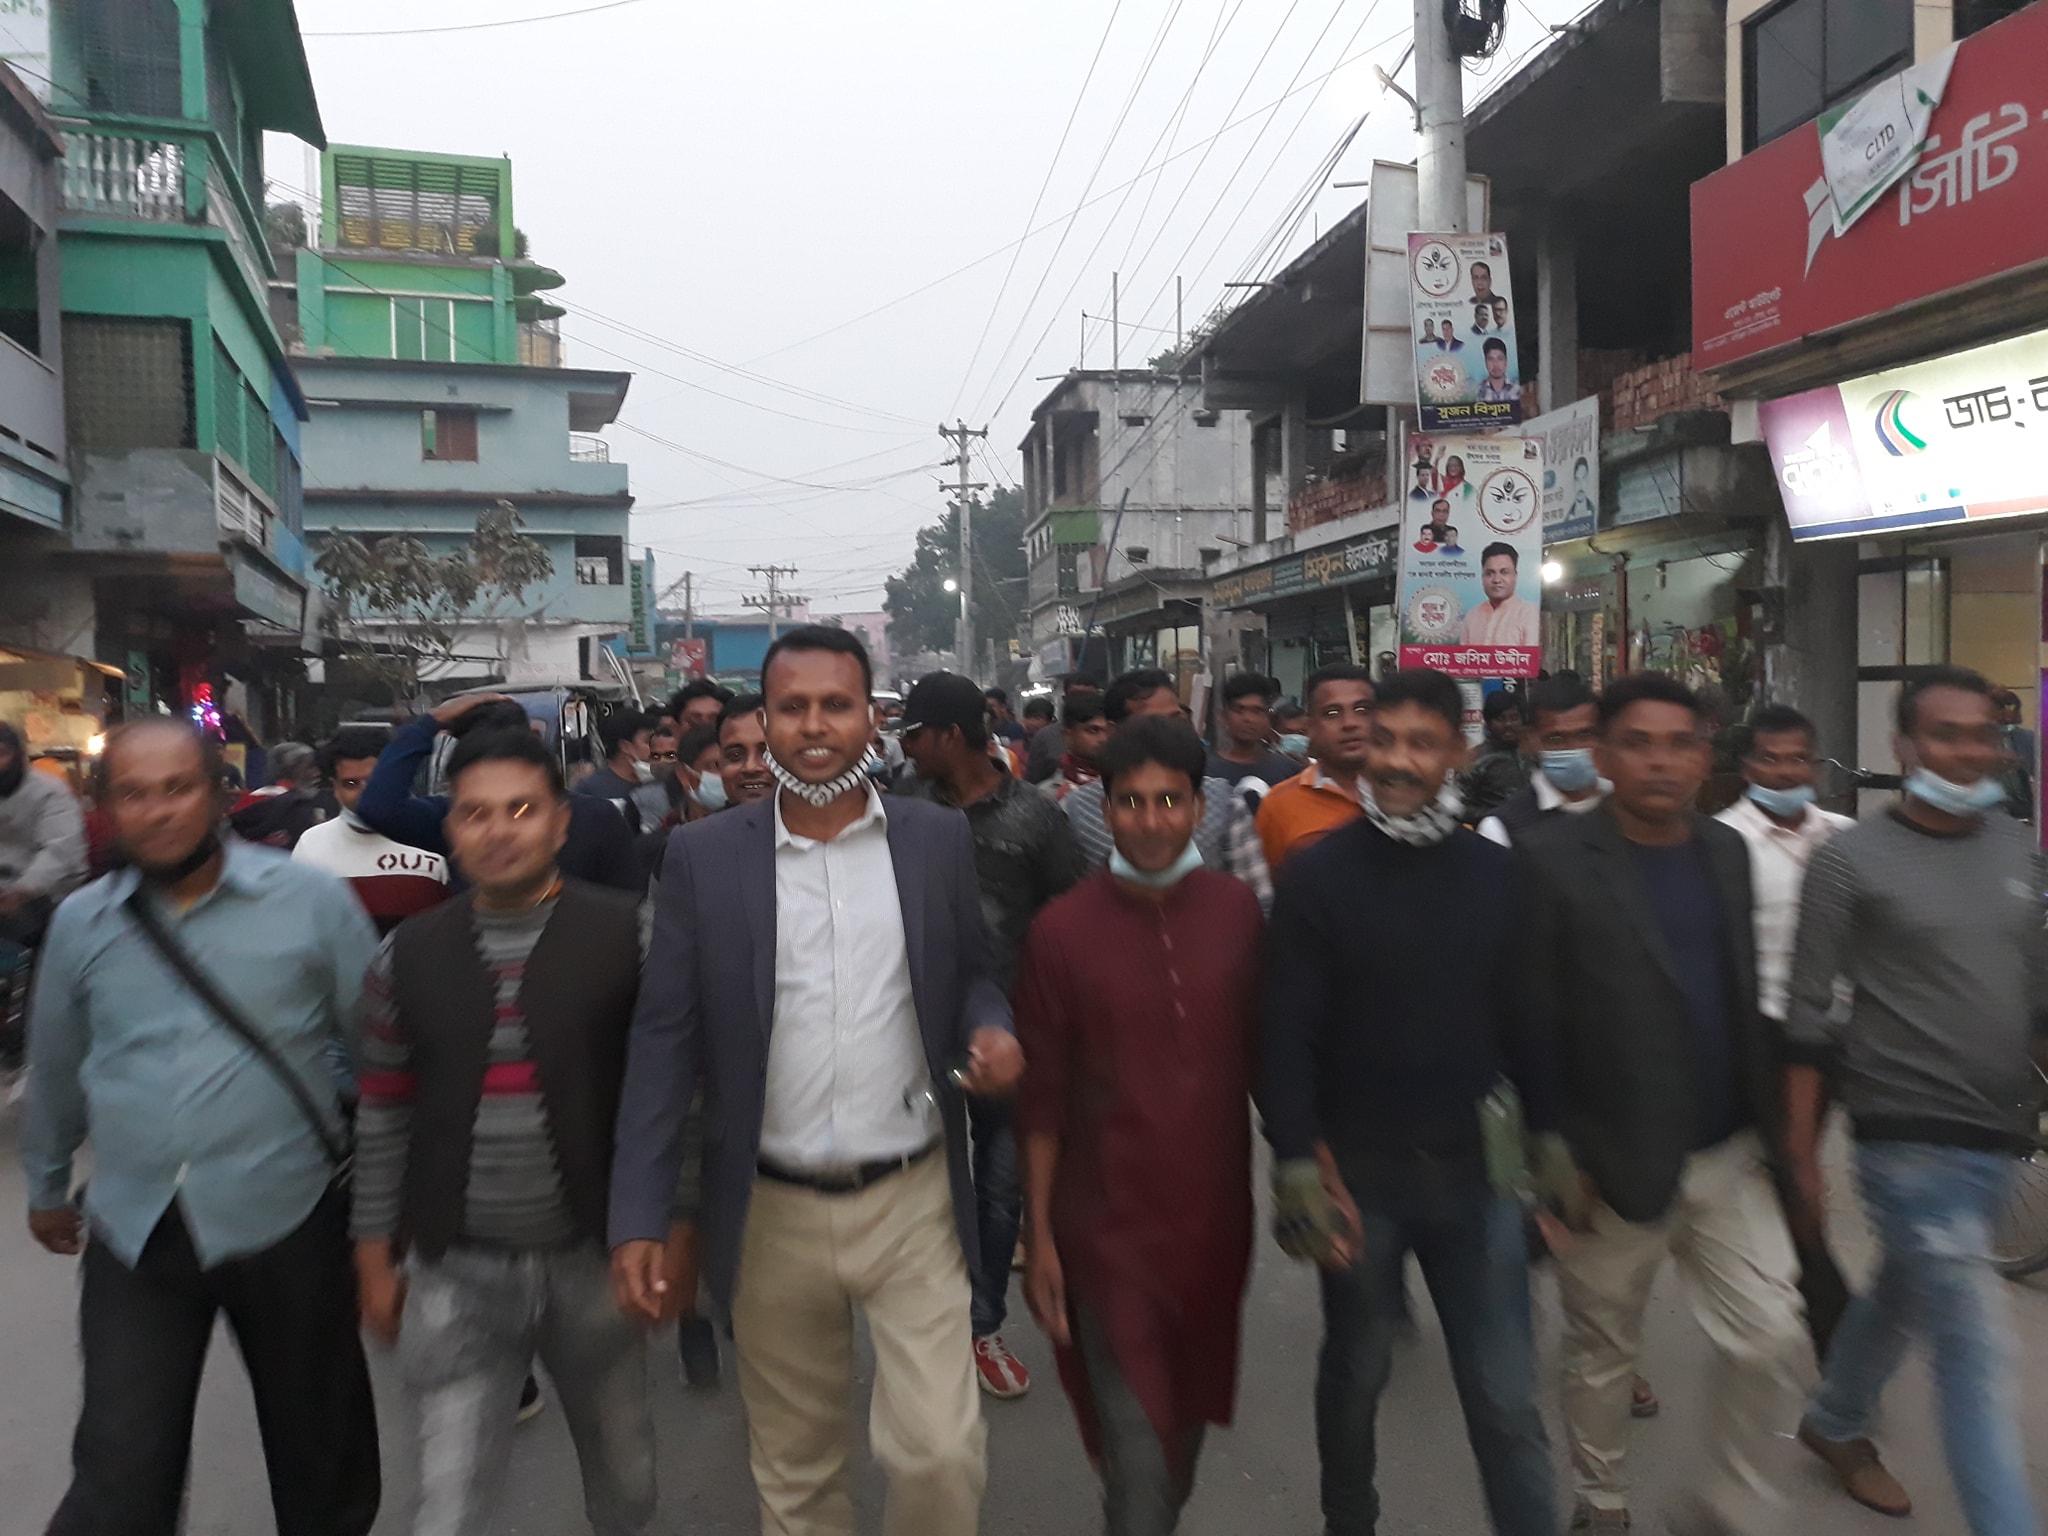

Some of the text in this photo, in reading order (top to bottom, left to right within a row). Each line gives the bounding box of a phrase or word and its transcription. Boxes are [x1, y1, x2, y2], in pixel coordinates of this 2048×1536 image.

[1865, 123, 1896, 160] CLTD
[1899, 102, 2029, 227] সিটি
[1437, 402, 1512, 419] সুজন বিশ্বাস
[1423, 648, 1532, 666] মোঃ জসিম উদ্দীন
[377, 853, 439, 873] OUT
